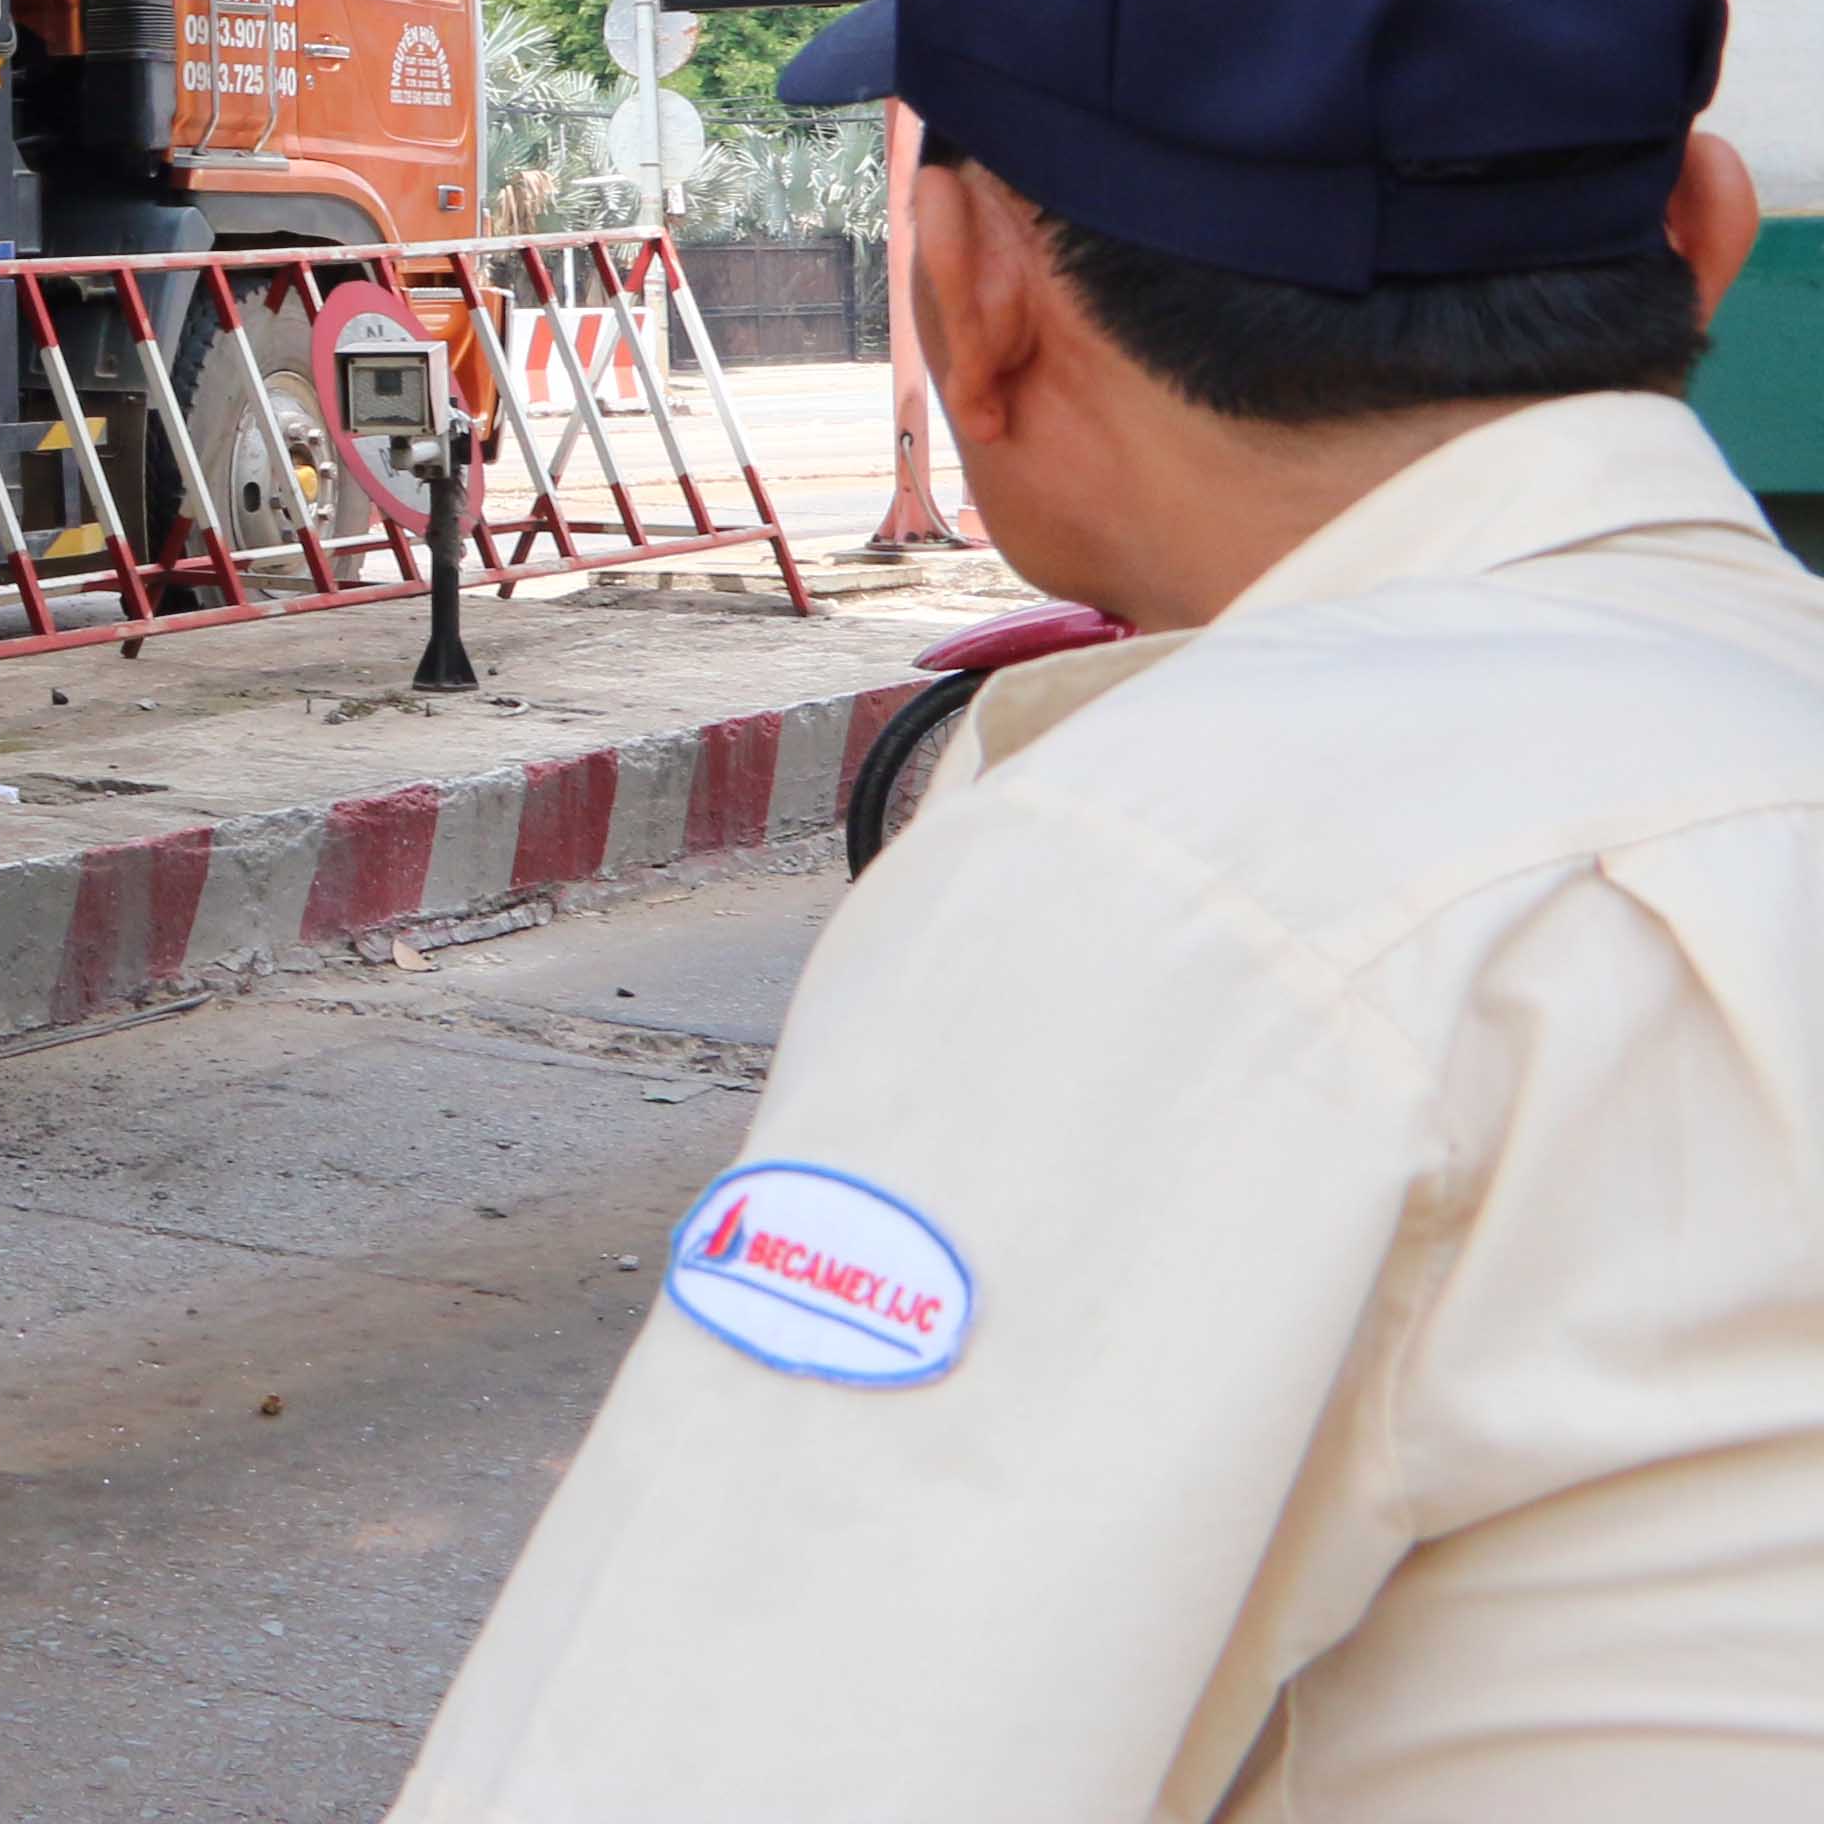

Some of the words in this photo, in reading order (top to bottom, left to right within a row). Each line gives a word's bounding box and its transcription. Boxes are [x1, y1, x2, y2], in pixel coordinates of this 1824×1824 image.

[184, 15, 266, 49] 093.907
[183, 61, 264, 95] 093.725
[746, 1231, 887, 1310] BECAMEX
